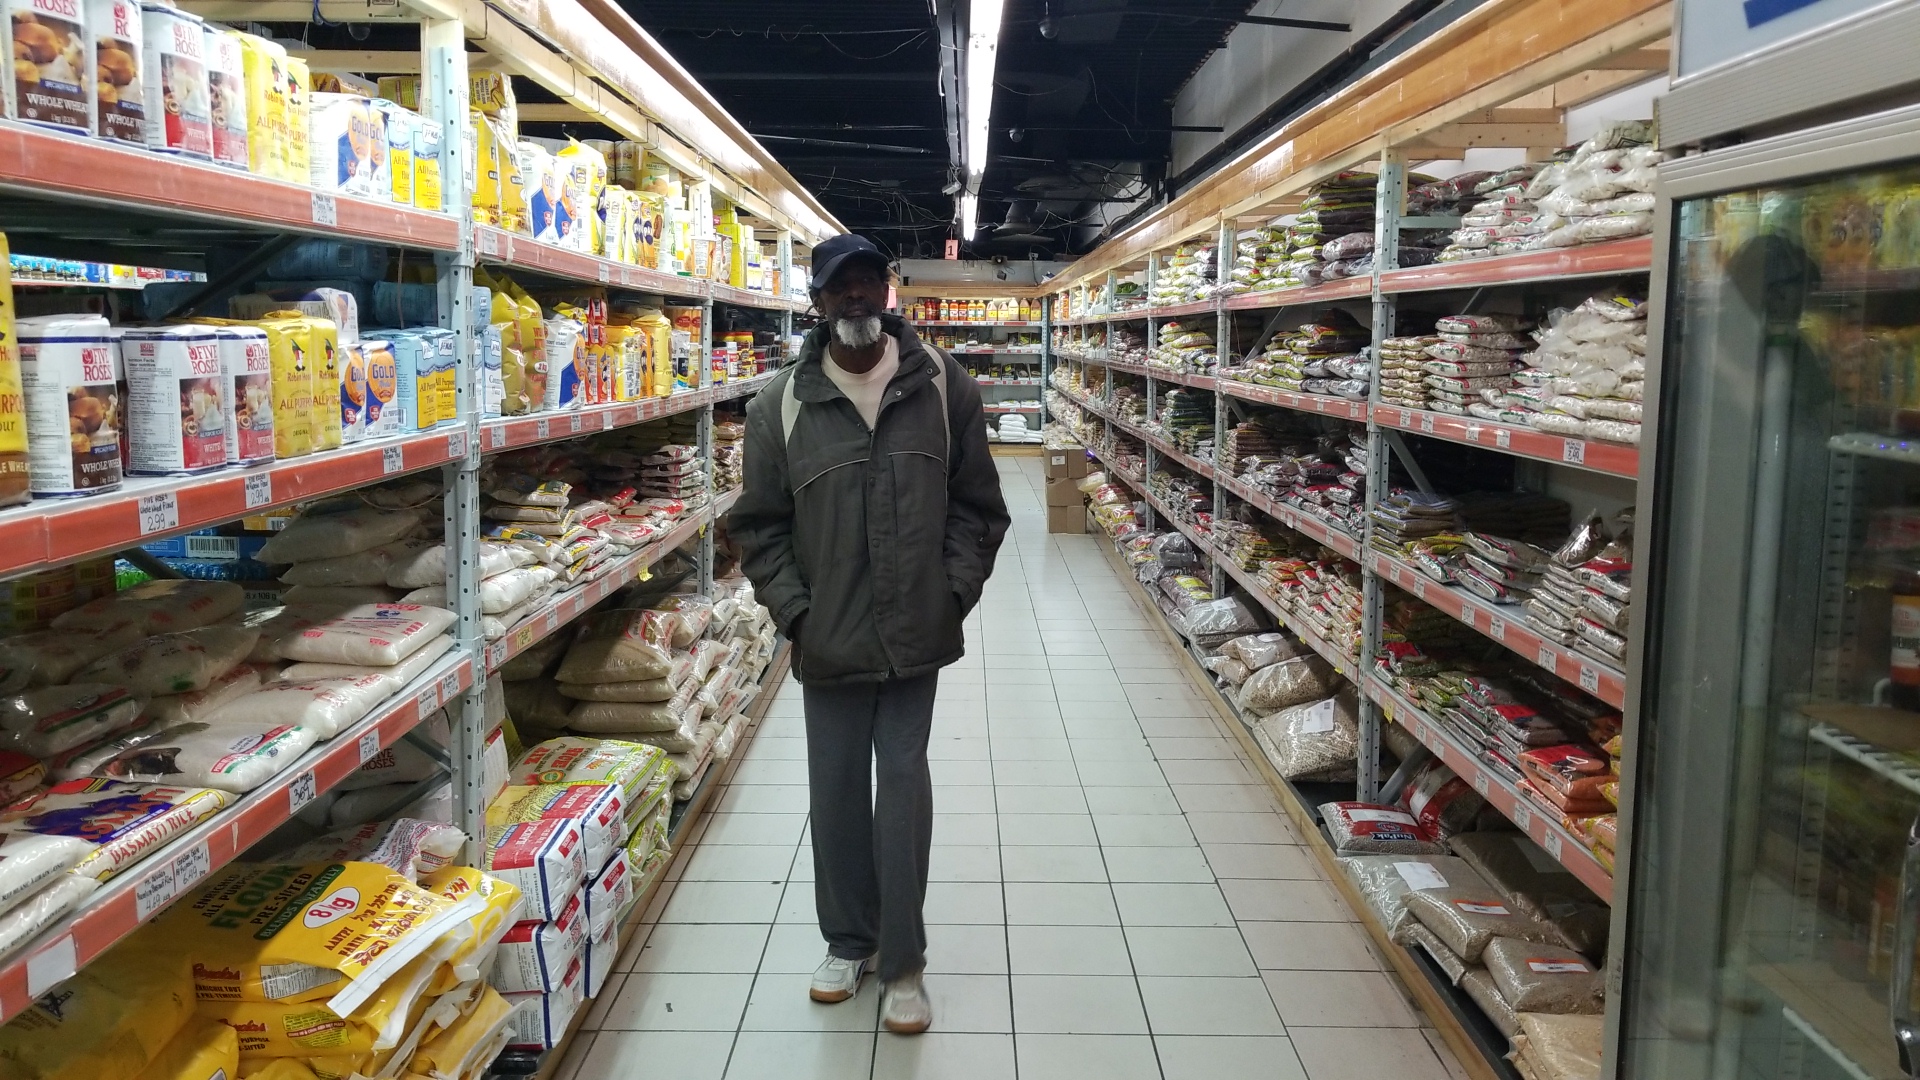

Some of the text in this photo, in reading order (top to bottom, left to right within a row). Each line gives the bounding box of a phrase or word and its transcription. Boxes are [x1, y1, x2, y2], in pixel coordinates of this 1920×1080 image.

[26, 93, 63, 108] WHOLE
[257, 115, 271, 128] ALL
[352, 116, 368, 137] GOLD
[947, 245, 954, 256] 1
[94, 348, 110, 363] FIVE
[196, 345, 218, 359] FIVE
[253, 343, 268, 357] FIVE
[191, 359, 219, 375] ROSES
[247, 358, 269, 372] ROSES
[372, 364, 395, 379] GOLD
[83, 365, 113, 381] ROSES
[280, 398, 294, 410] ALL
[313, 395, 326, 406] ALL
[81, 461, 107, 474] WHOLE
[250, 488, 264, 506] 2.99
[147, 512, 166, 531] 2.99
[271, 593, 277, 603] g
[379, 747, 394, 759] IVE
[361, 757, 396, 771] ROSES
[76, 787, 187, 841] SMATI
[109, 809, 196, 865] BASMATI RICE
[192, 874, 241, 910] ENRICHED
[208, 865, 306, 929] FLOUR
[249, 873, 314, 925] PRE-SIFTED
[201, 903, 225, 918] ALL
[308, 897, 356, 919] 8 kg
[260, 905, 298, 937] BLENDS
